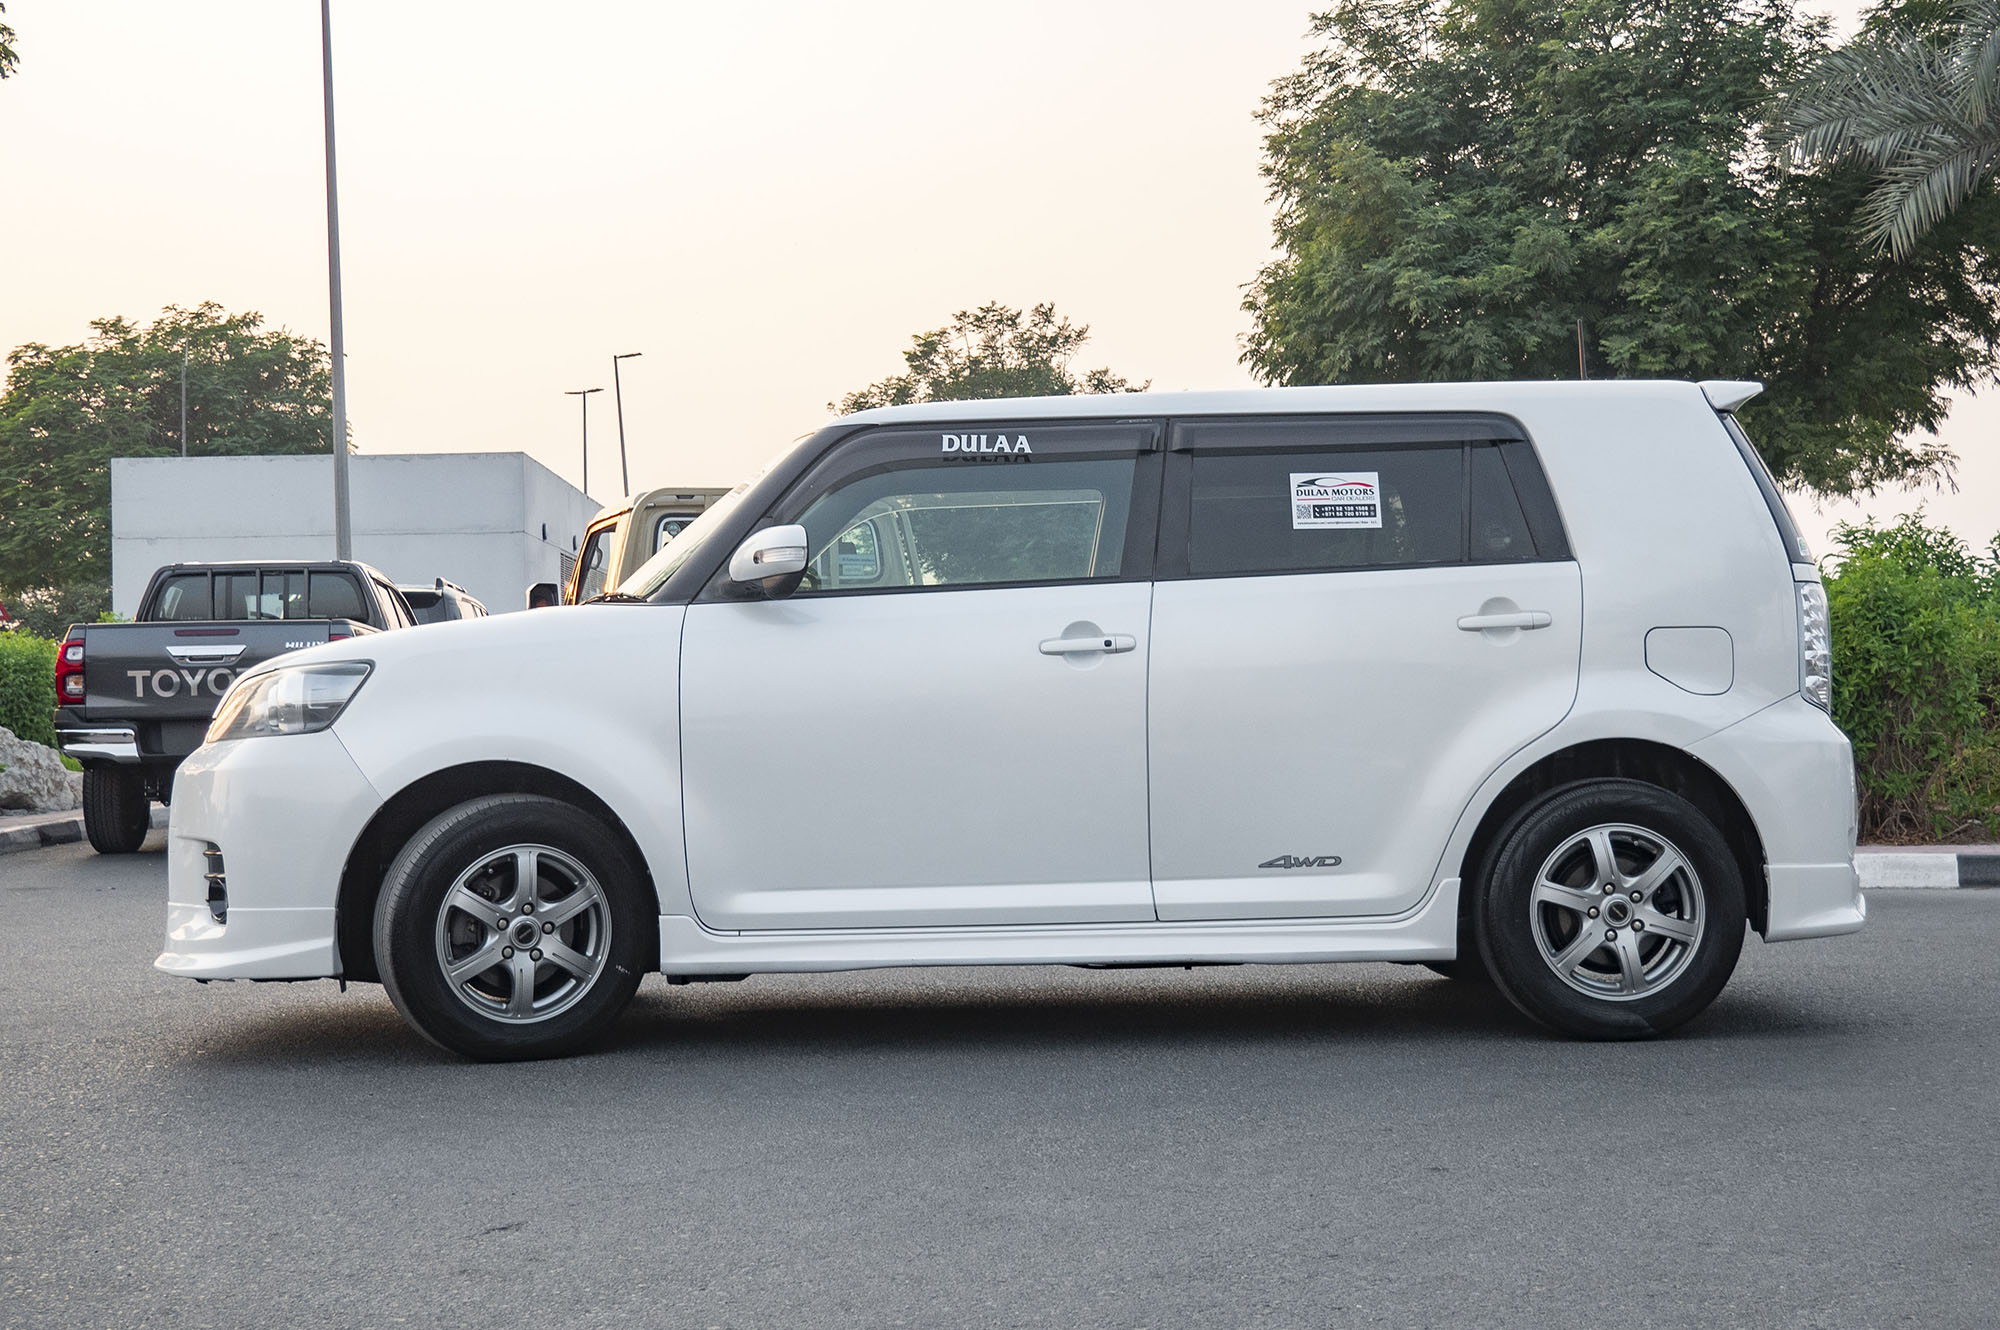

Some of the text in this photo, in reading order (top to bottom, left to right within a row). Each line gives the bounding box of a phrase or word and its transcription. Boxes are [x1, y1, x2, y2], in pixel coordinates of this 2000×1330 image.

[942, 434, 1032, 453] DULAA
[1296, 488, 1375, 497] DULAA MOTORS
[127, 667, 249, 698] TOYO
[1258, 855, 1342, 869] 4WD
